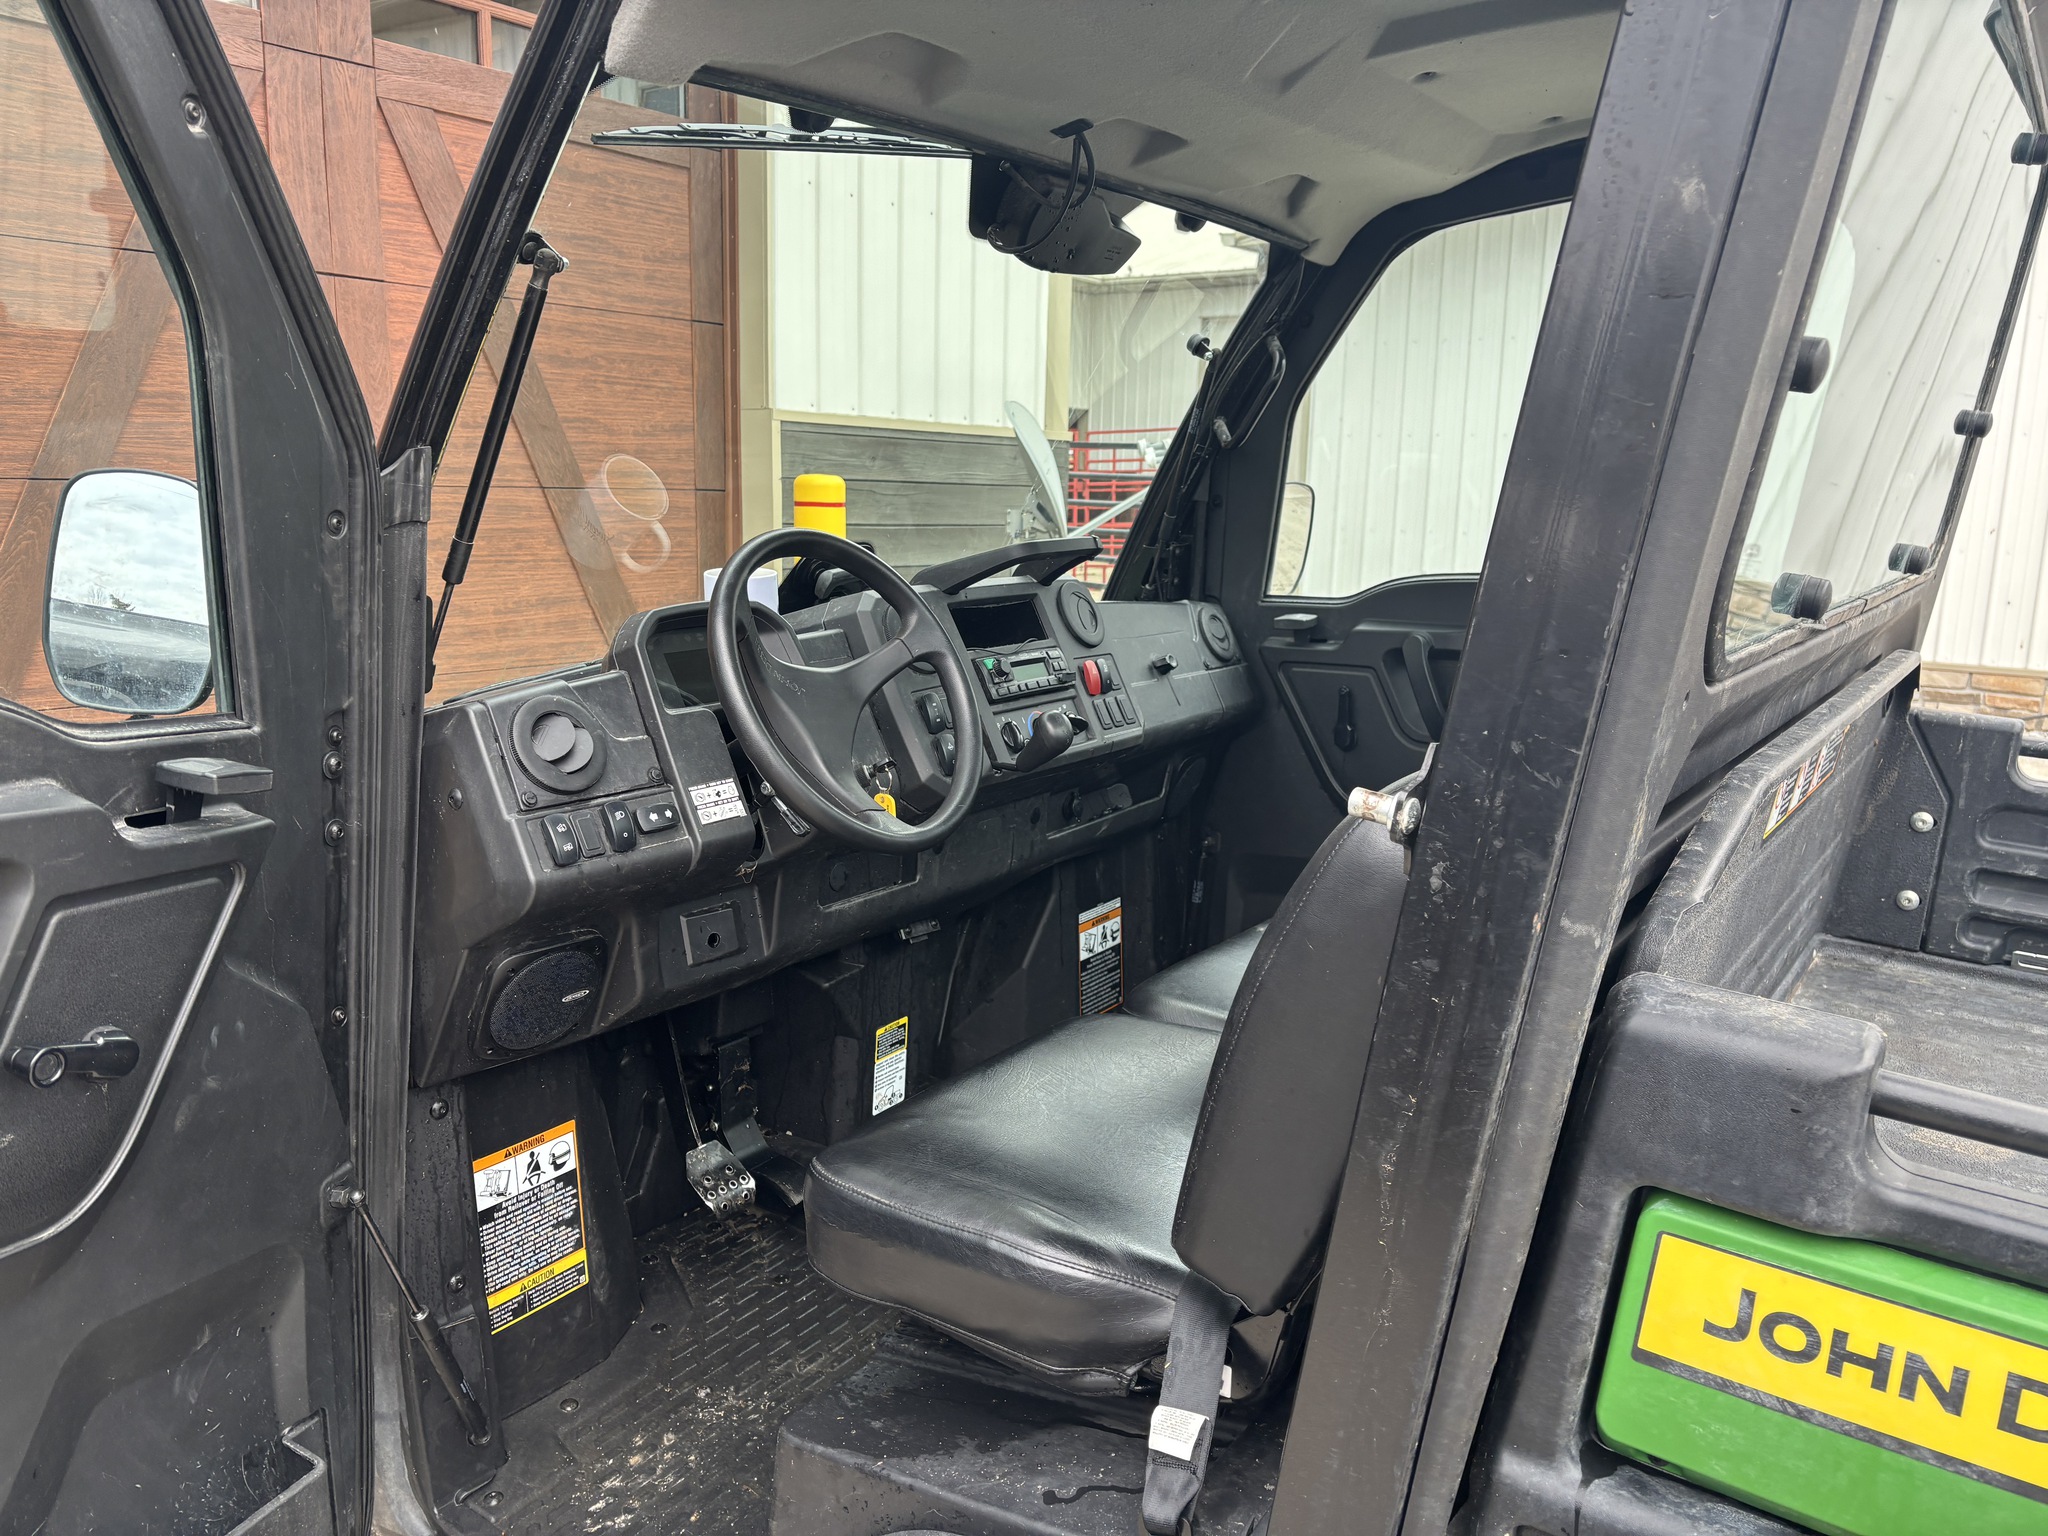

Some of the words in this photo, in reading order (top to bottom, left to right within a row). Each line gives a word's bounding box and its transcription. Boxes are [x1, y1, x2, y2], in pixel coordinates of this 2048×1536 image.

[511, 1134, 545, 1155] WARNING
[527, 1267, 555, 1289] CAUTION
[1702, 1287, 1971, 1418] JOHN
